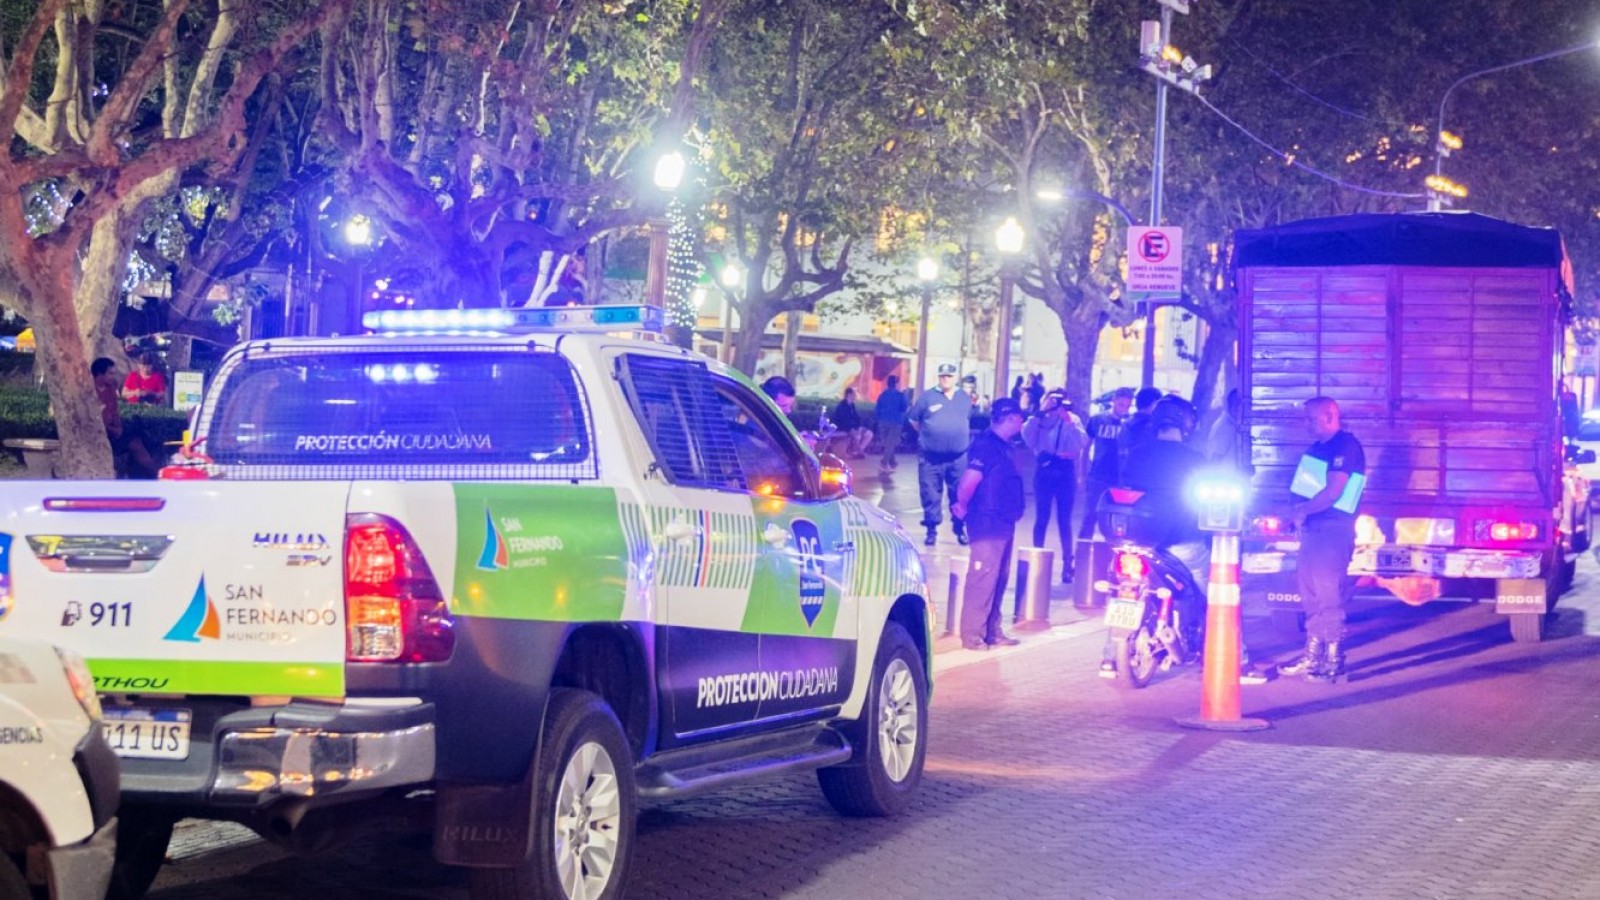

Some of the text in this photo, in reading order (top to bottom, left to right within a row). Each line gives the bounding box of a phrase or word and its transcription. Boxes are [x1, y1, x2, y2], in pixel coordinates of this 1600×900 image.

[294, 429, 493, 451] PROTECCIÓN CIUDADANA
[500, 516, 525, 533] SAN
[252, 531, 331, 551] HILUX
[507, 534, 564, 555] FERNANDO
[224, 583, 263, 601] SAN
[1267, 591, 1302, 603] DODG
[1497, 595, 1543, 605] DODGE
[89, 602, 132, 627] 911
[226, 607, 338, 626] FERNANDO
[226, 631, 290, 641] MUNICIPIO
[779, 665, 839, 701] CIUDADANA
[151, 725, 182, 753] US
[442, 825, 517, 842] HILUX
